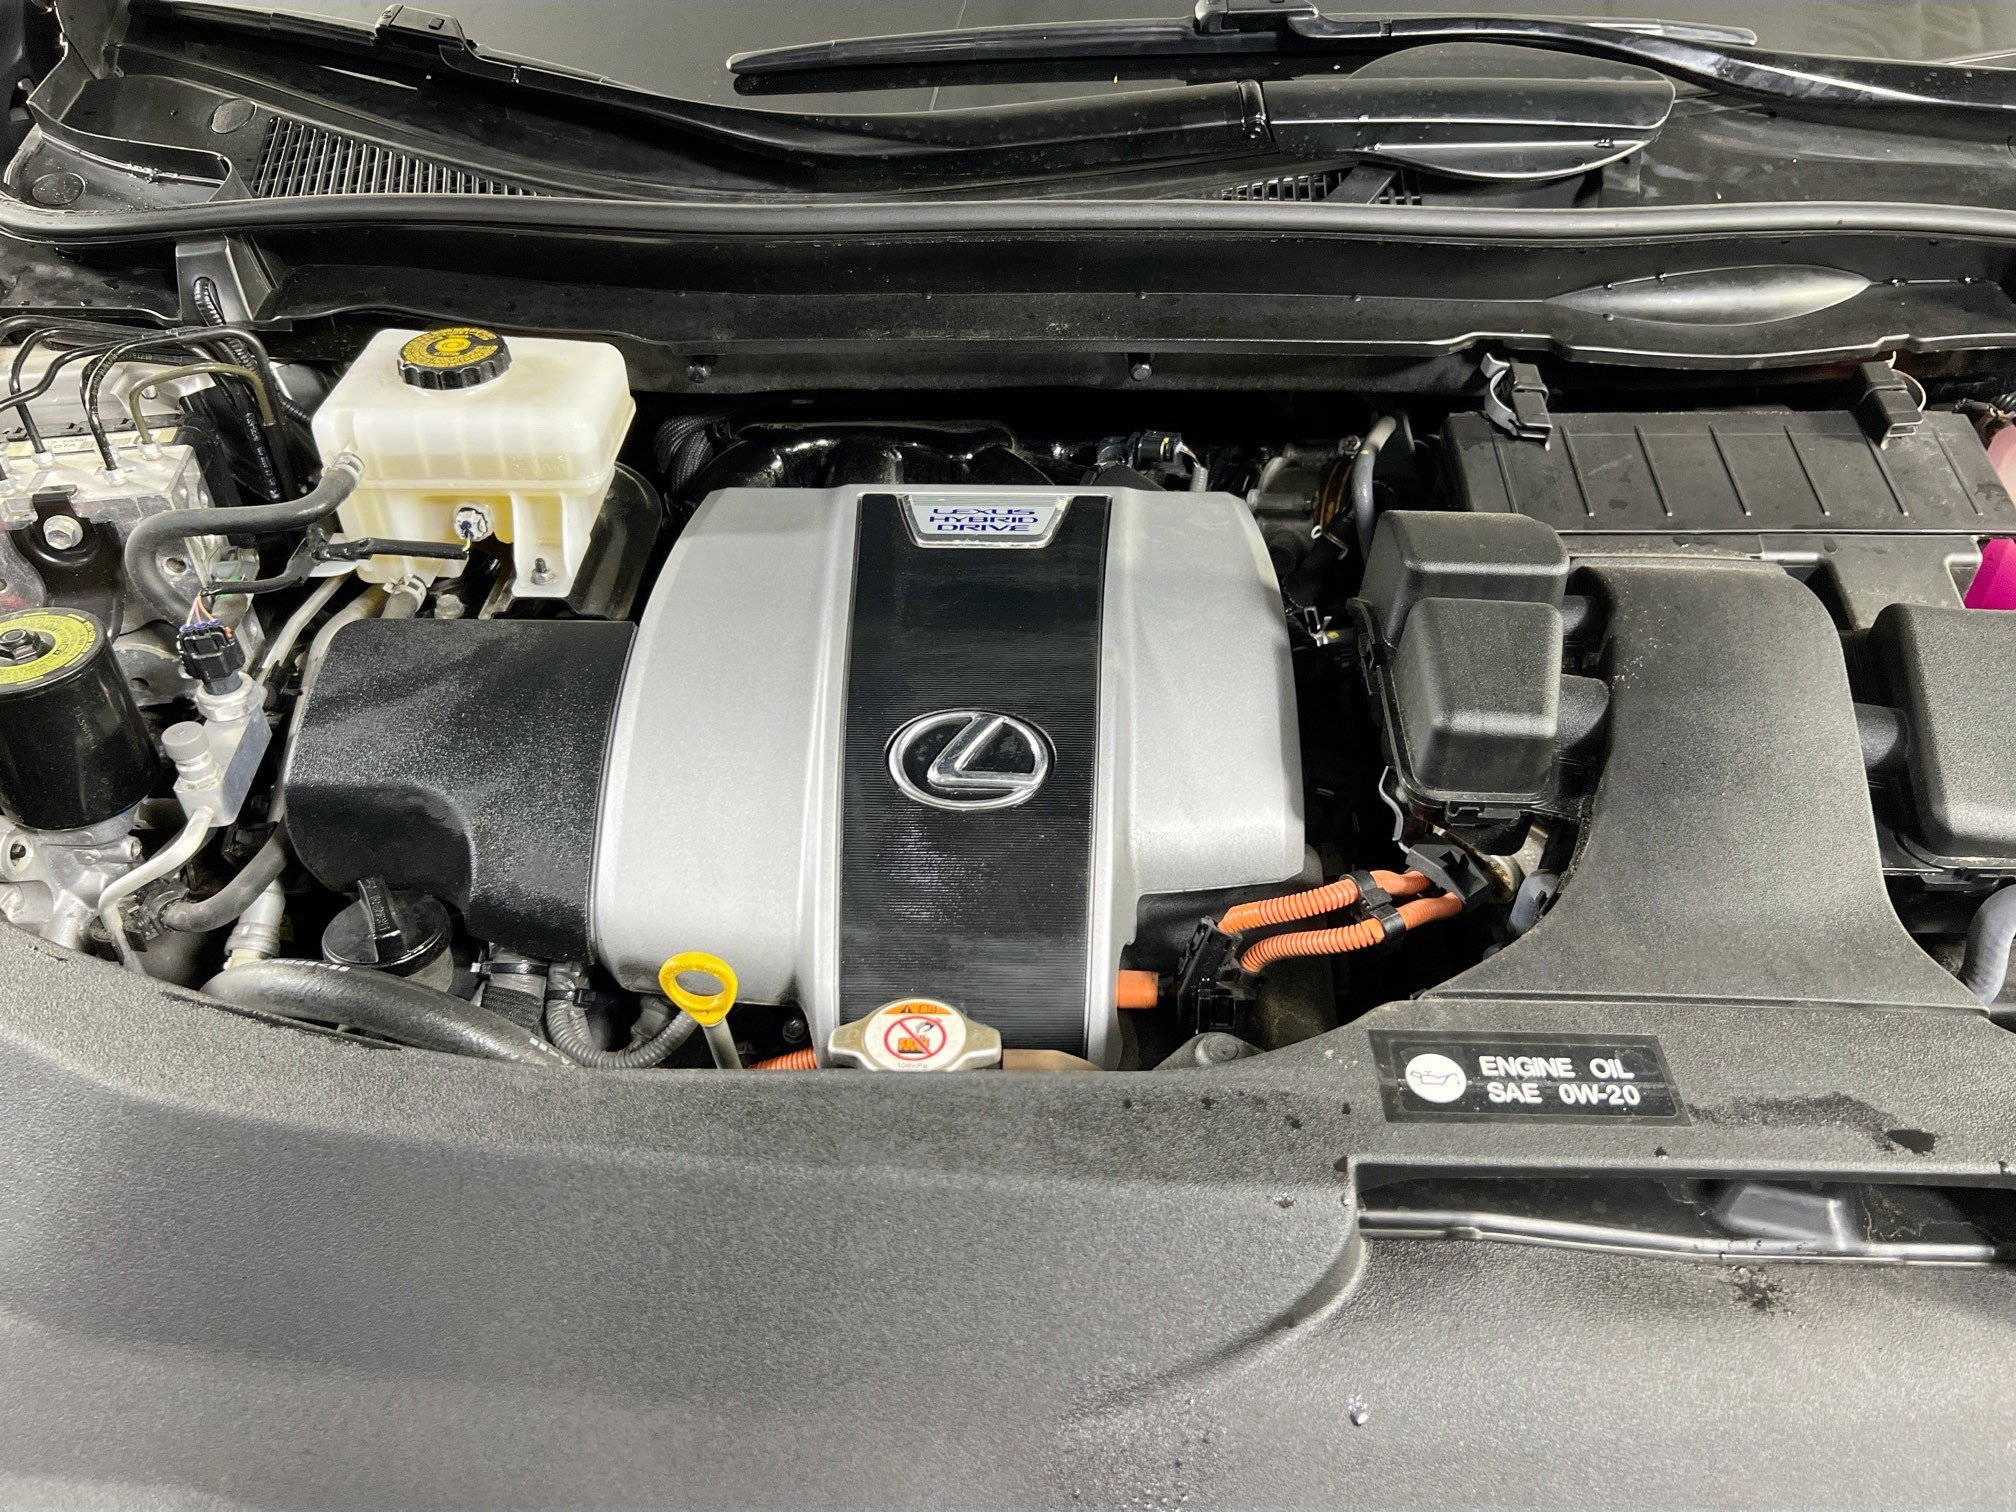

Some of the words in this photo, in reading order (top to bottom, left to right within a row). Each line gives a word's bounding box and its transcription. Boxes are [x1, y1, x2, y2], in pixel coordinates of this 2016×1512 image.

[1478, 1055, 1576, 1078] ENGINE
[1589, 1057, 1634, 1080] OIL
[1487, 1081, 1543, 1104] SAE
[1558, 1083, 1641, 1106] 0W-20
